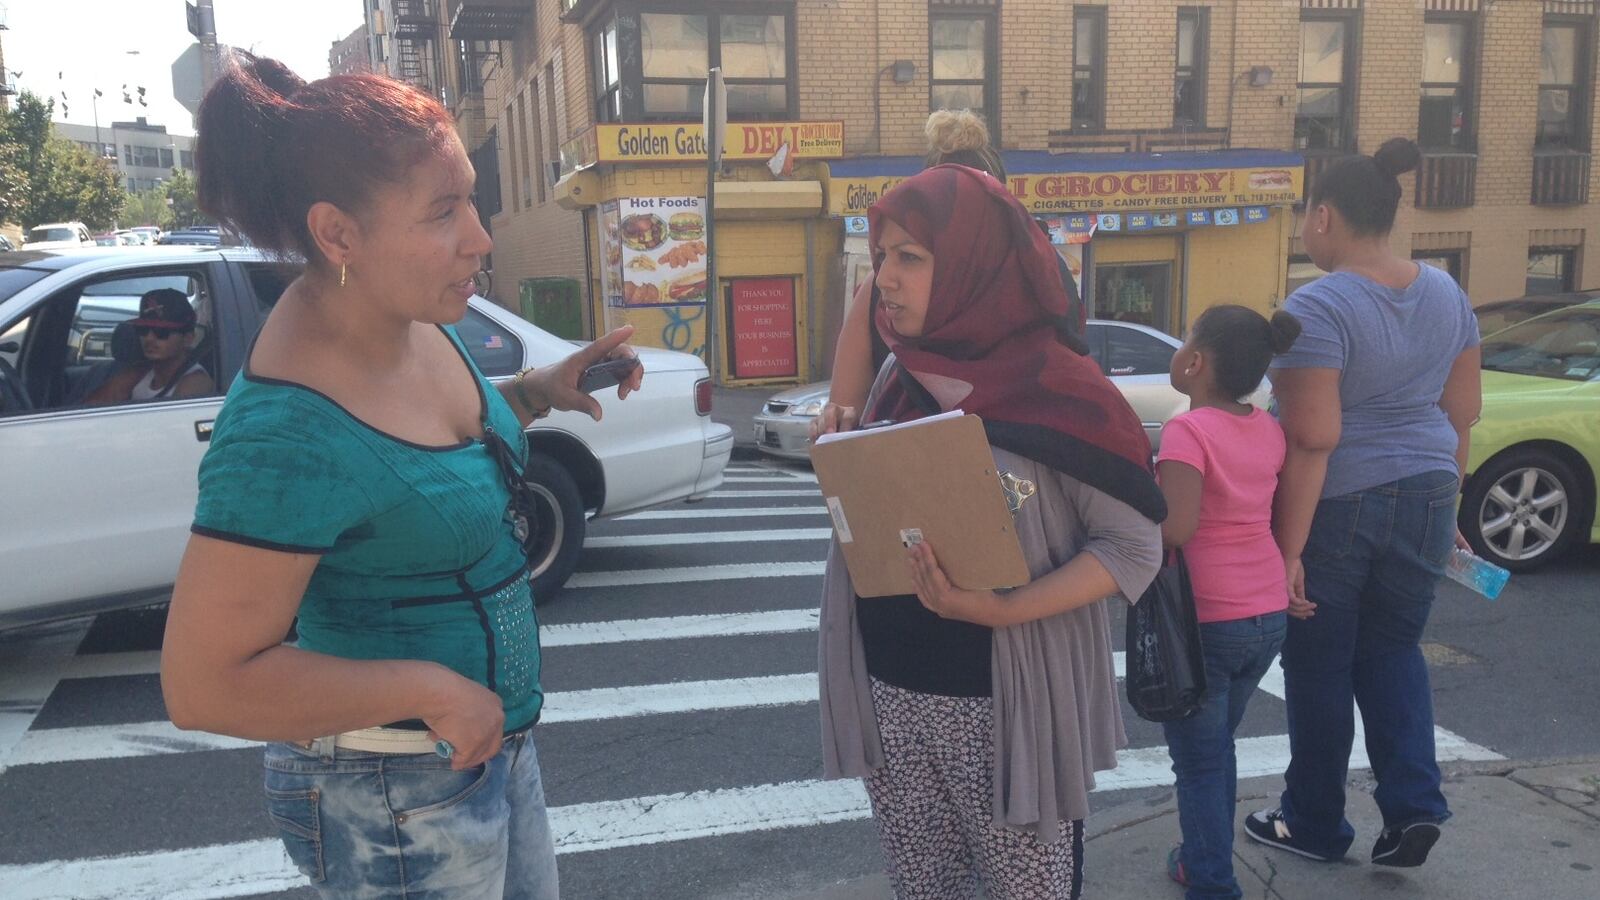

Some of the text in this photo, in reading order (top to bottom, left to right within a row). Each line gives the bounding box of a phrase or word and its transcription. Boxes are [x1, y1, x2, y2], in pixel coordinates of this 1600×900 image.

[617, 127, 669, 155] Golden
[742, 126, 800, 154] DELI
[1035, 172, 1228, 199] GROCERY
[630, 198, 654, 208] Hot
[658, 197, 699, 207] Foods
[1033, 200, 1104, 209] CIGARETTES
[1113, 198, 1151, 207] CANDY
[1154, 196, 1179, 206] FREE
[1181, 195, 1227, 204] DELIVERY
[742, 289, 784, 299] THANK YOU
[737, 303, 790, 312] FOR SHOPPING
[753, 318, 773, 326] HERE
[737, 331, 792, 341] YOUR BUSINESS
[761, 345, 769, 353] IS
[742, 359, 790, 368] APPRECIATED
